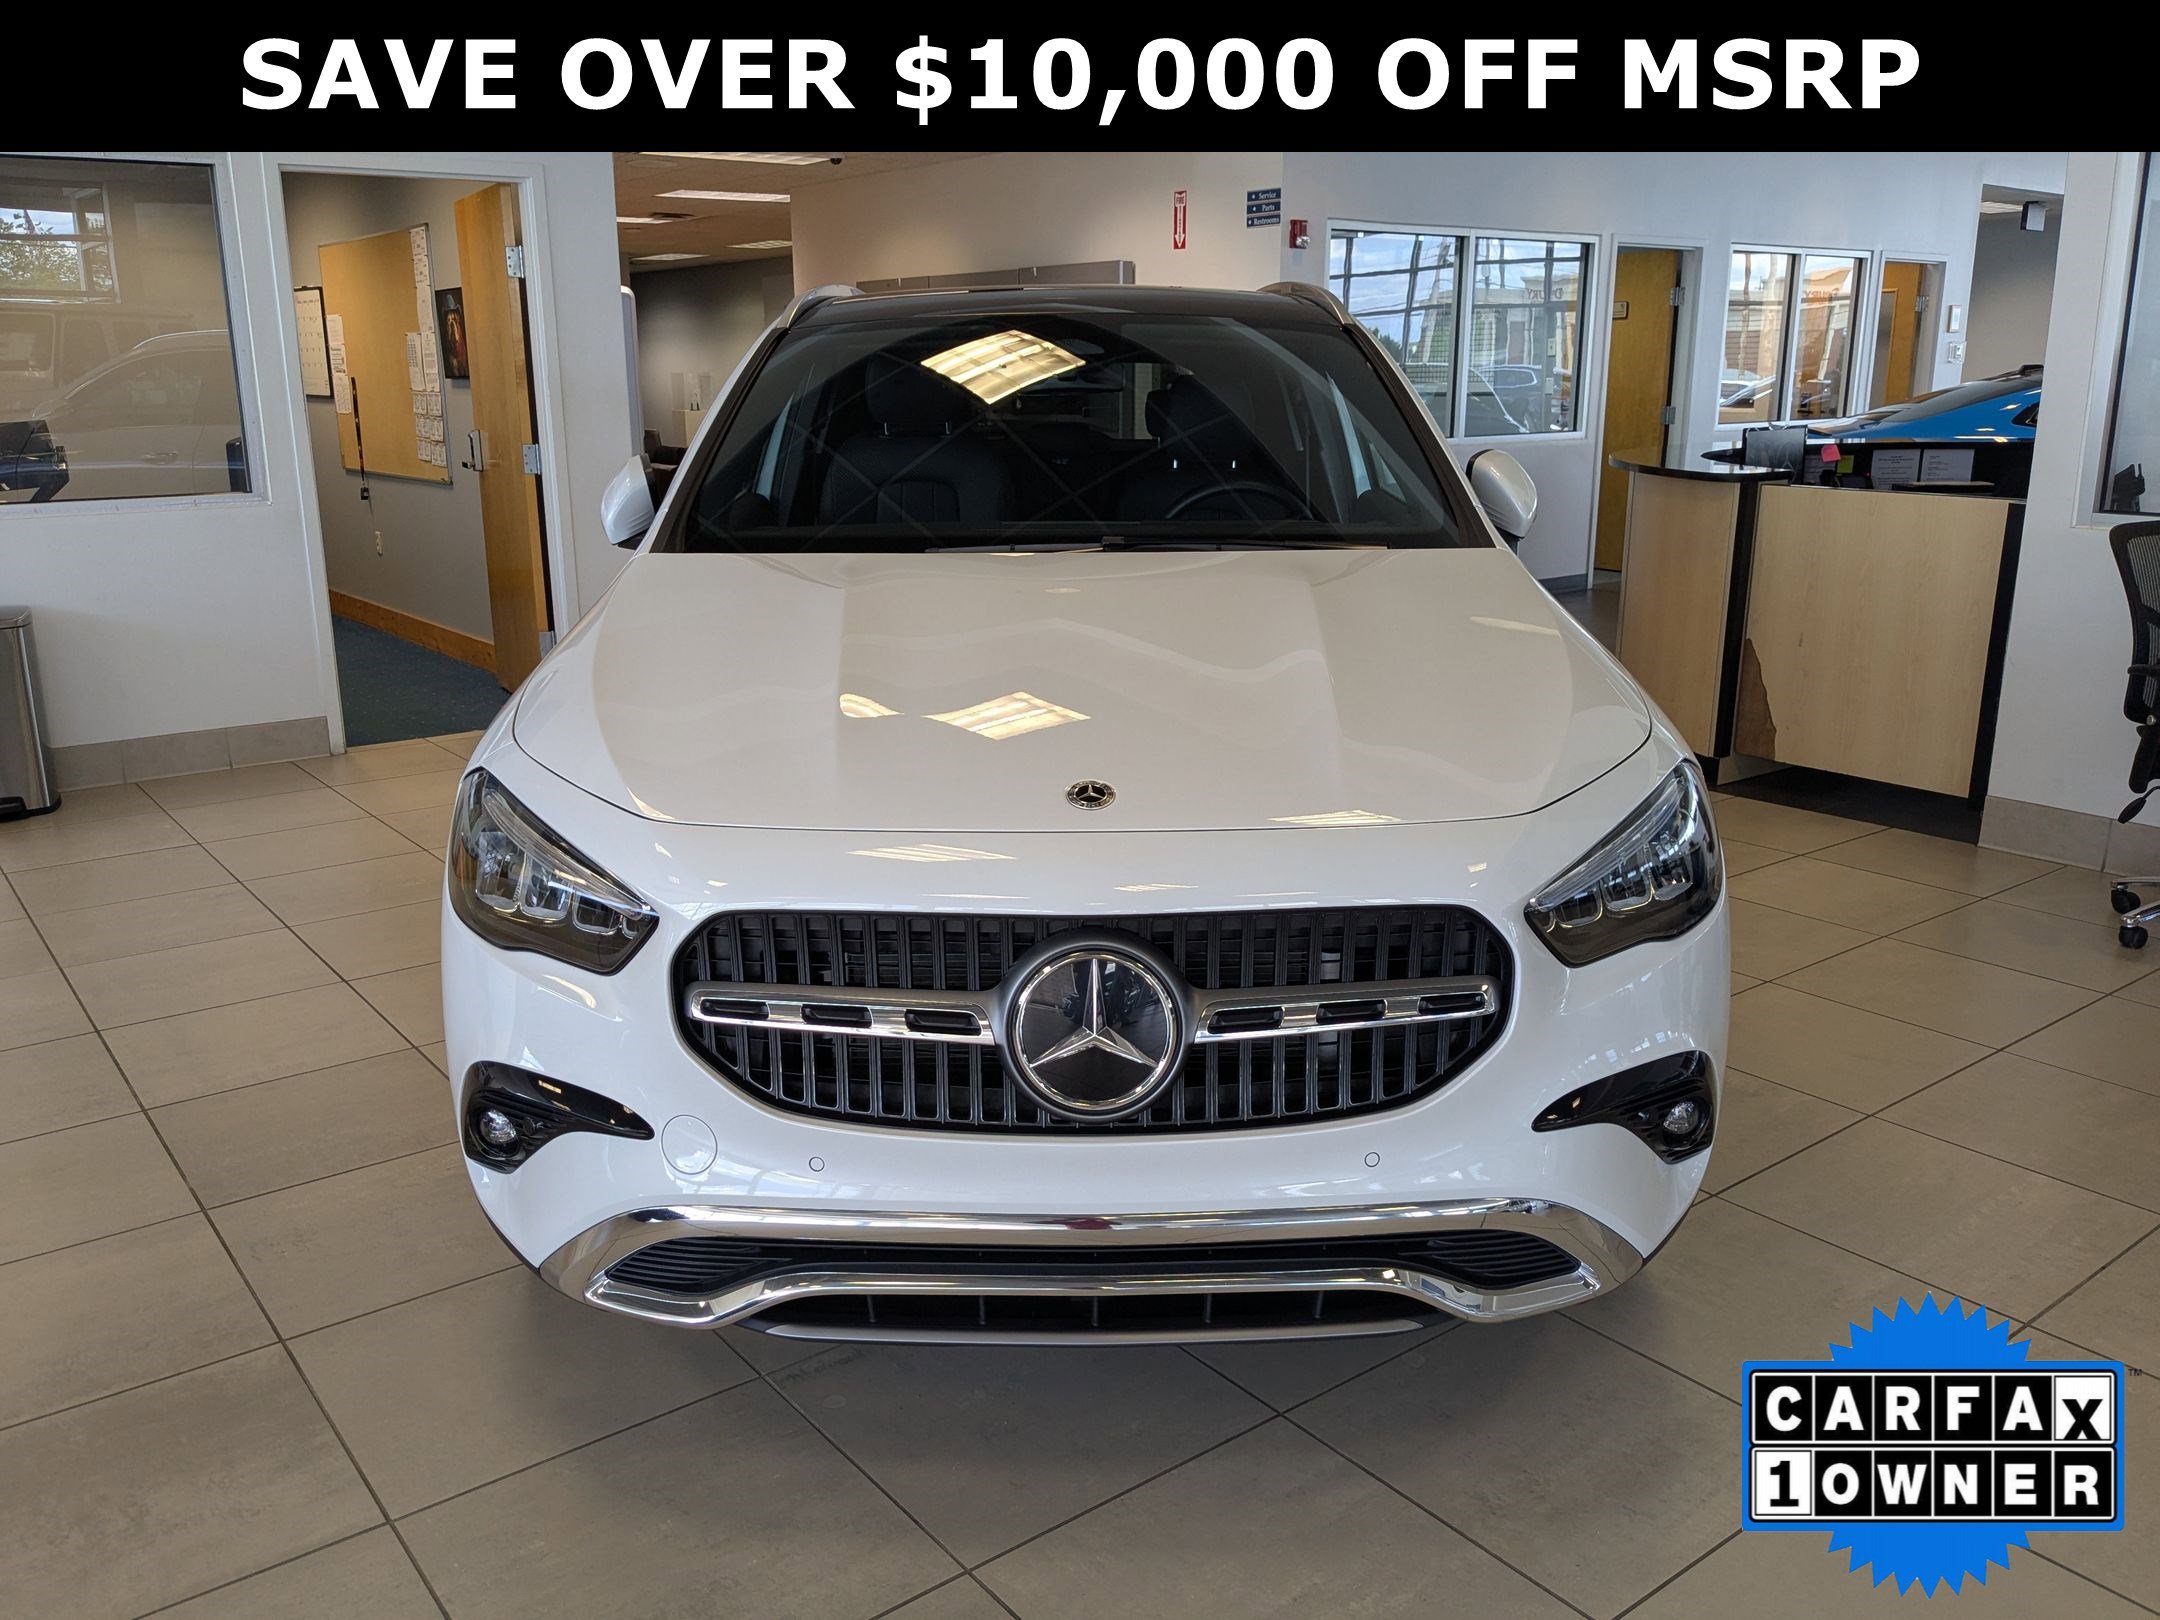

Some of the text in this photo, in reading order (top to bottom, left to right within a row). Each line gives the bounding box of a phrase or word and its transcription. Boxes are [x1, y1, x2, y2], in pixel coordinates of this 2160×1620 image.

[1259, 191, 1276, 199] Service
[1262, 204, 1275, 212] Parts
[1253, 217, 1279, 225] Restrooms
